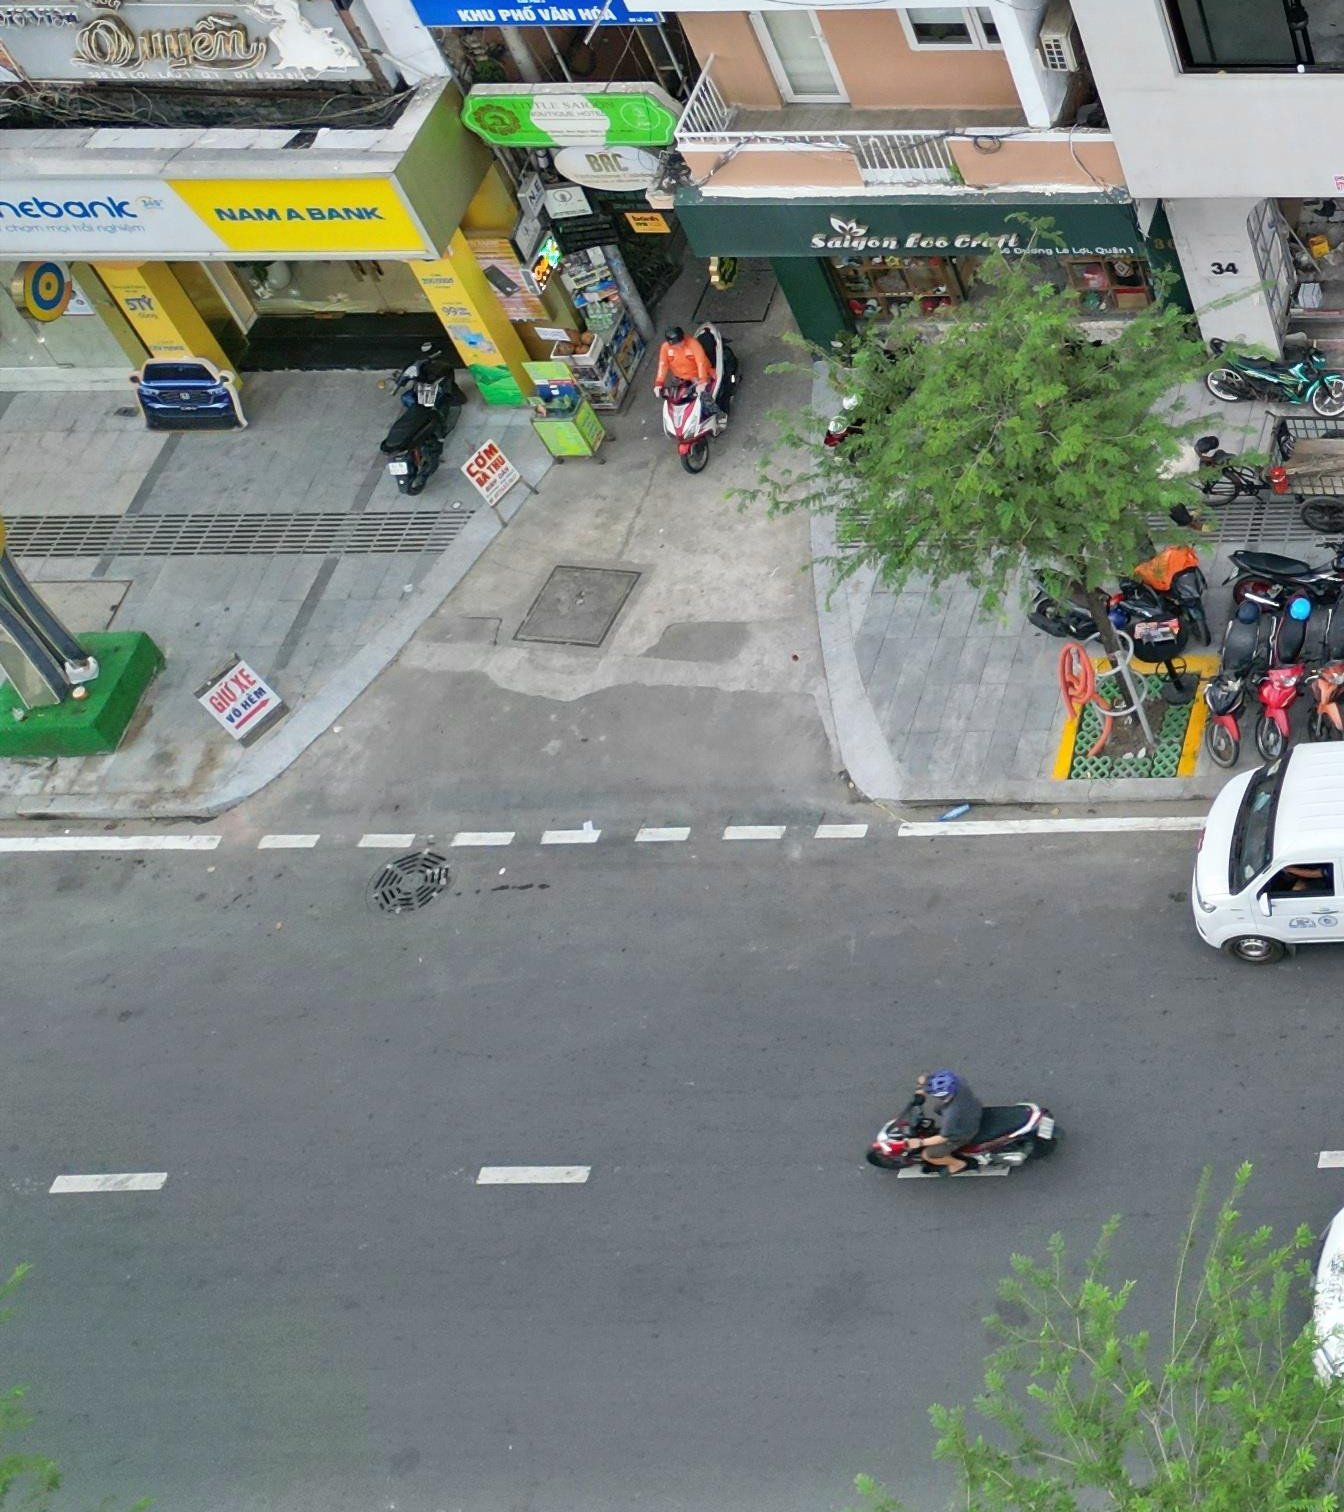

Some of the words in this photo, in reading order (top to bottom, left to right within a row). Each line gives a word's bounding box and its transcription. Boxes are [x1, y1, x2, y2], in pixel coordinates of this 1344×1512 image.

[457, 9, 496, 22] KHU
[499, 6, 536, 21] PHỐ
[540, 6, 577, 21] VĂN
[215, 207, 281, 221] NAM
[286, 207, 305, 221] A
[310, 206, 386, 221] BANK
[810, 235, 898, 251] Saigon
[904, 234, 949, 248] Eco
[1211, 262, 1239, 275] 34
[230, 668, 256, 694] XE
